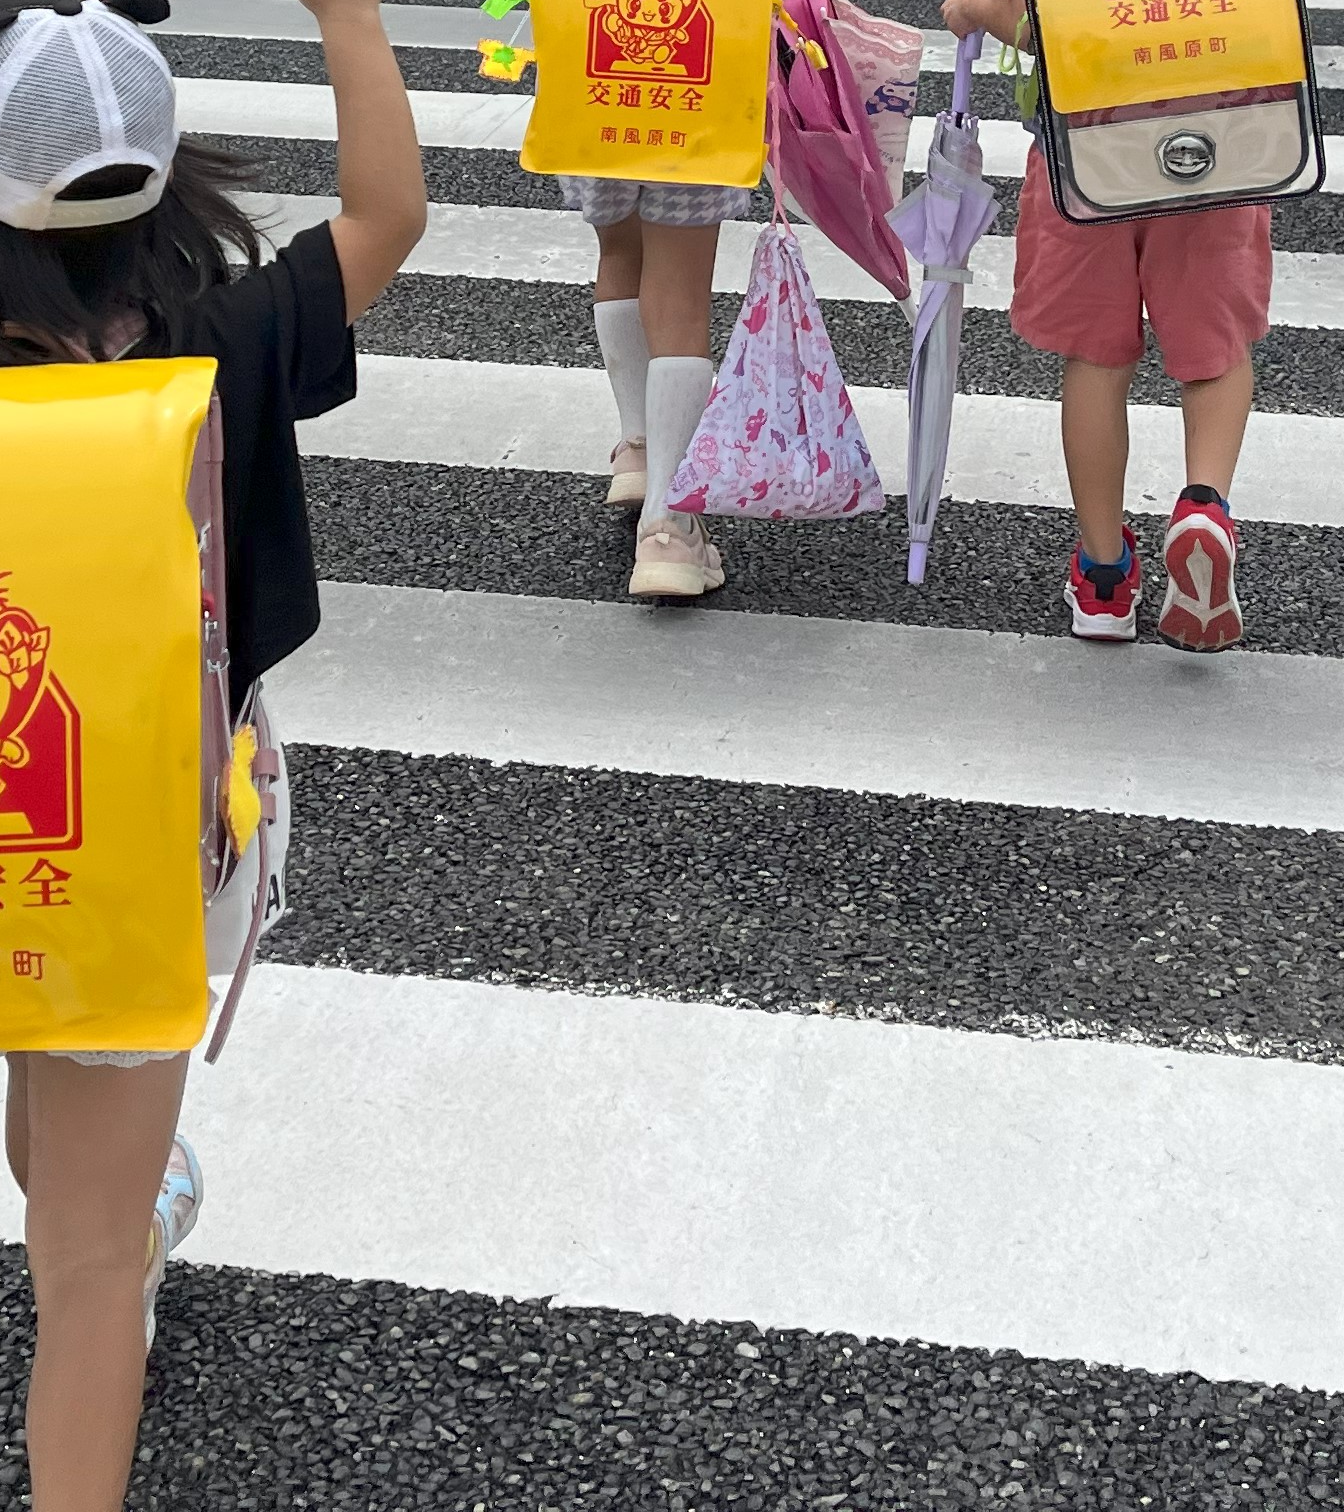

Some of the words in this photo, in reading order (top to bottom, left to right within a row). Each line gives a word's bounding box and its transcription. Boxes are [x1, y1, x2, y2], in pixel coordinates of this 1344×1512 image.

[1133, 37, 1228, 66] 南風原町
[586, 81, 705, 112] 交通安全
[600, 126, 688, 148] 南風原町
